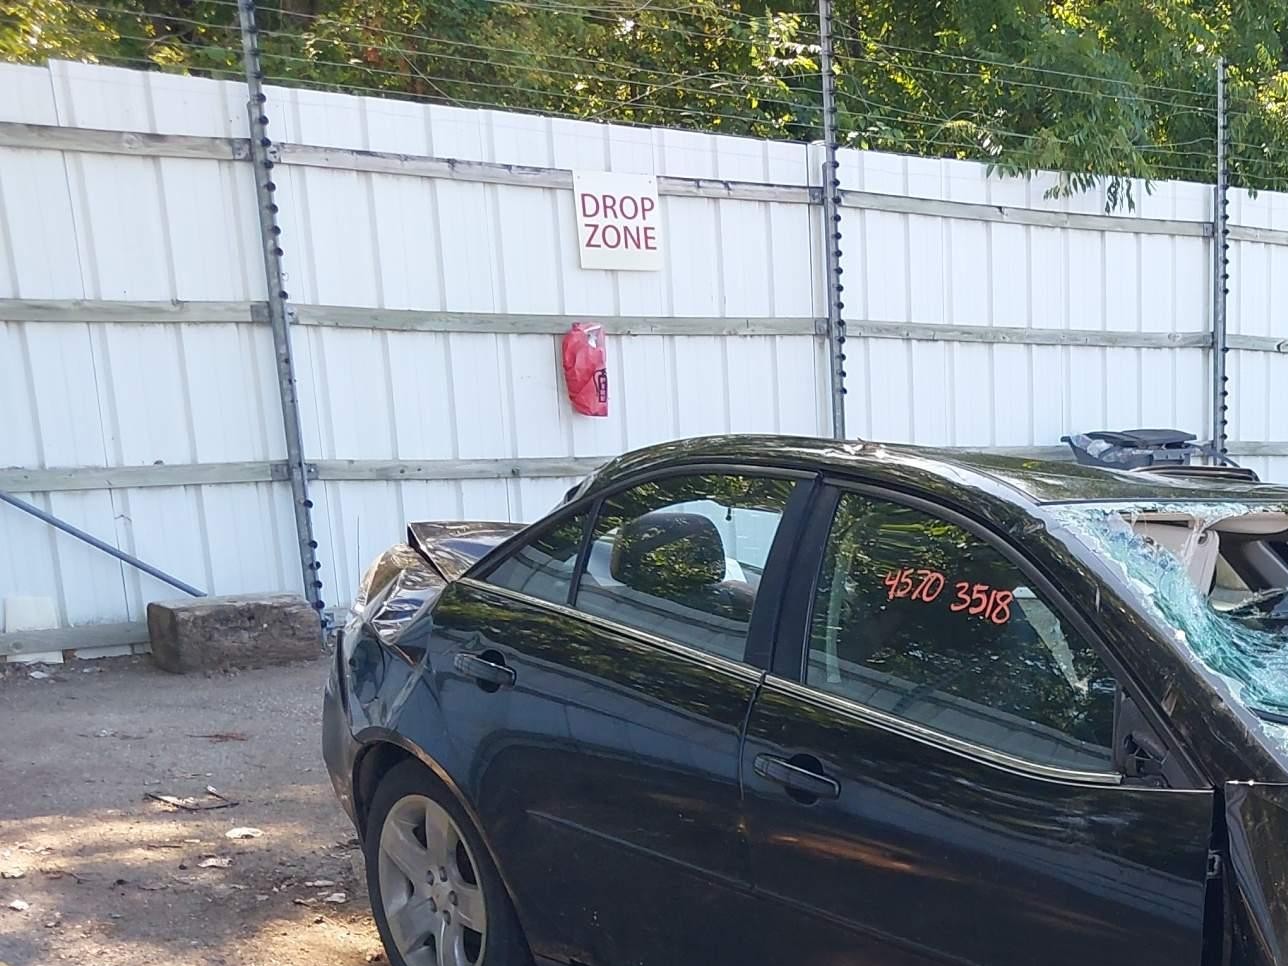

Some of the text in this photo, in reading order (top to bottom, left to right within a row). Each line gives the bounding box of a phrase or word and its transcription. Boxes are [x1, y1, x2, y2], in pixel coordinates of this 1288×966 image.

[580, 193, 655, 220] DROP
[584, 223, 657, 250] ZONE
[884, 567, 1014, 624] 4570 3518
